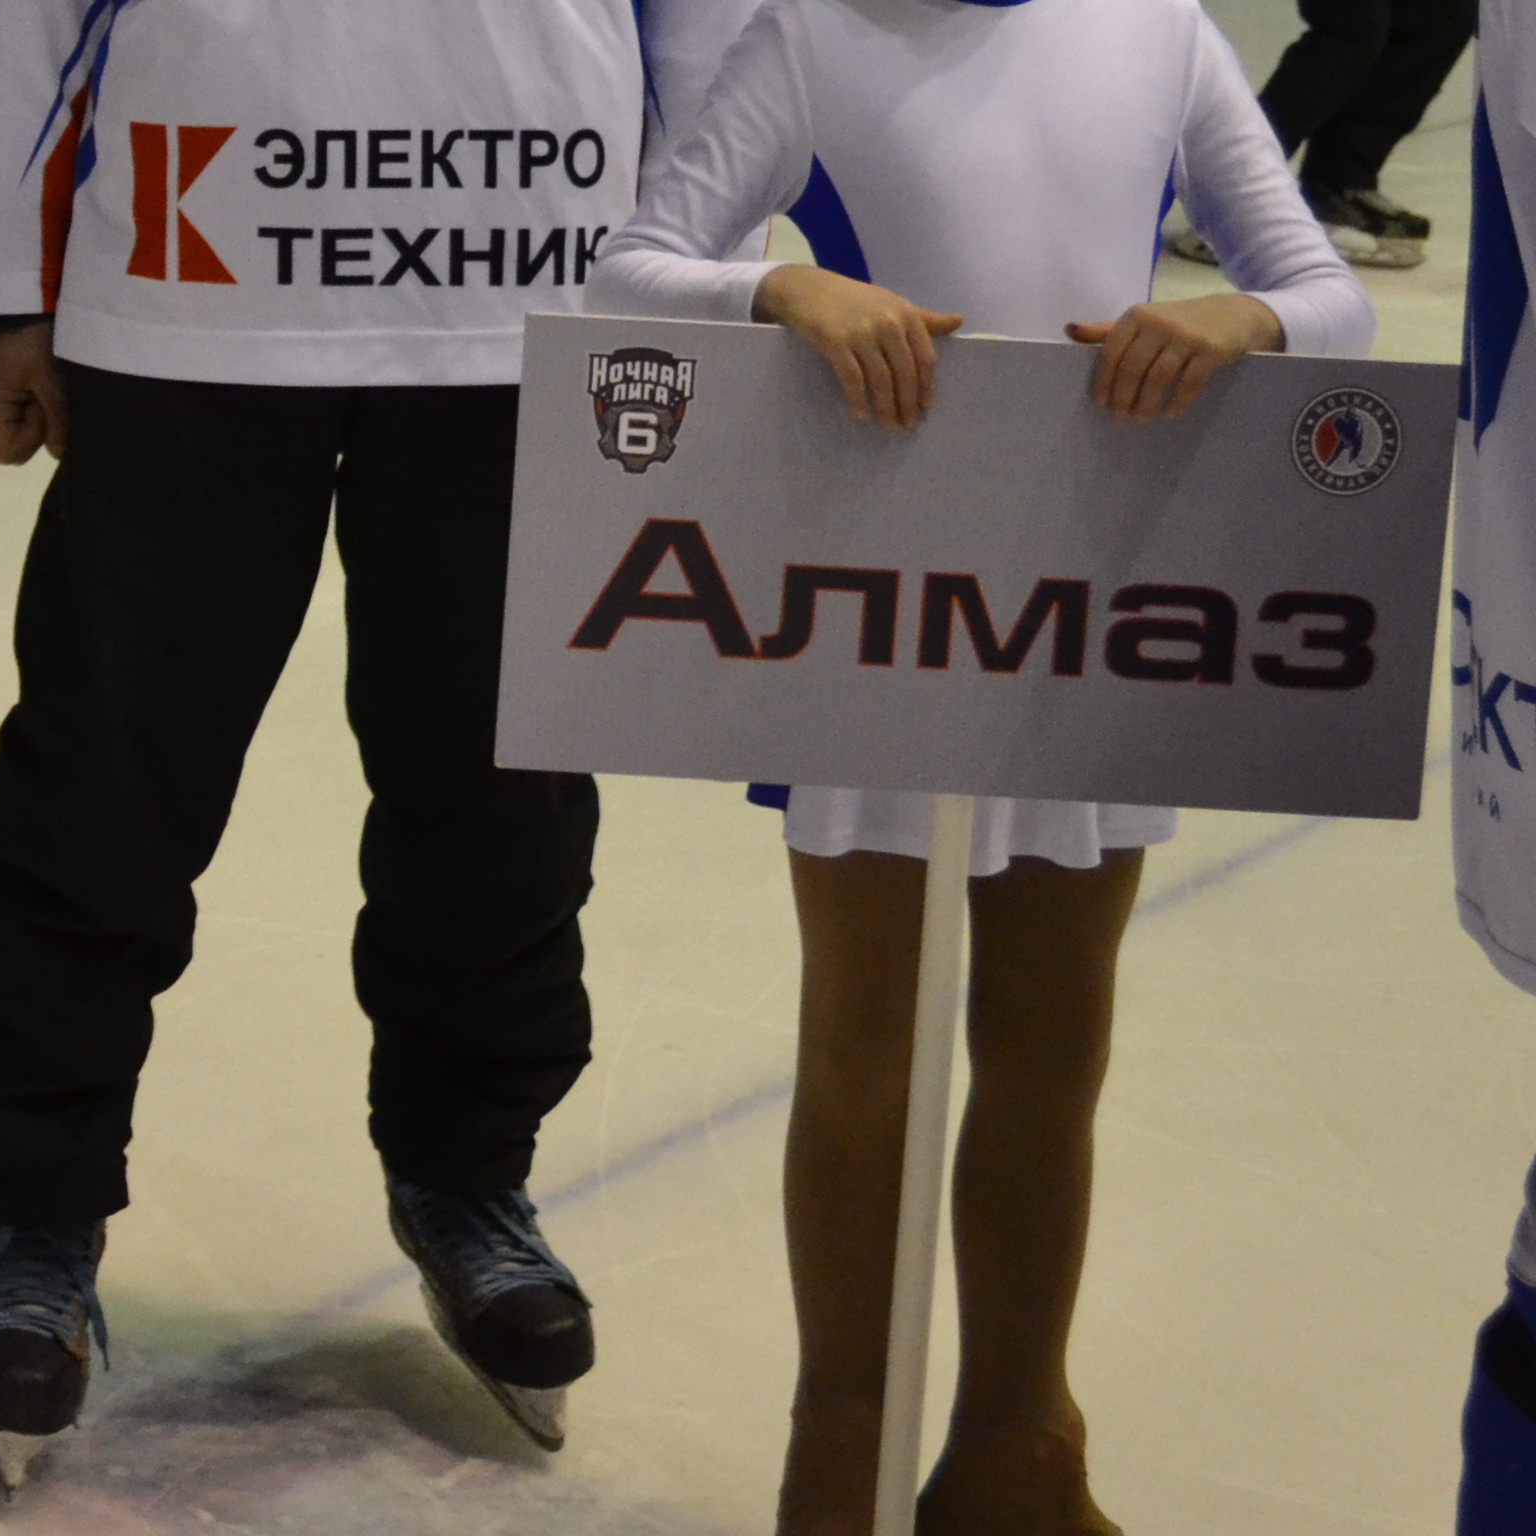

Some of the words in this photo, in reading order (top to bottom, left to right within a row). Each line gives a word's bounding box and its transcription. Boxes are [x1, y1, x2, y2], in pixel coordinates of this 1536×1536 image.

[254, 128, 607, 191] ЭЛЕКТРО
[590, 355, 693, 398] НОЧНАЯ
[612, 382, 669, 406] ЛИГА
[617, 411, 659, 455] 6
[567, 517, 1379, 693] Алмаз
